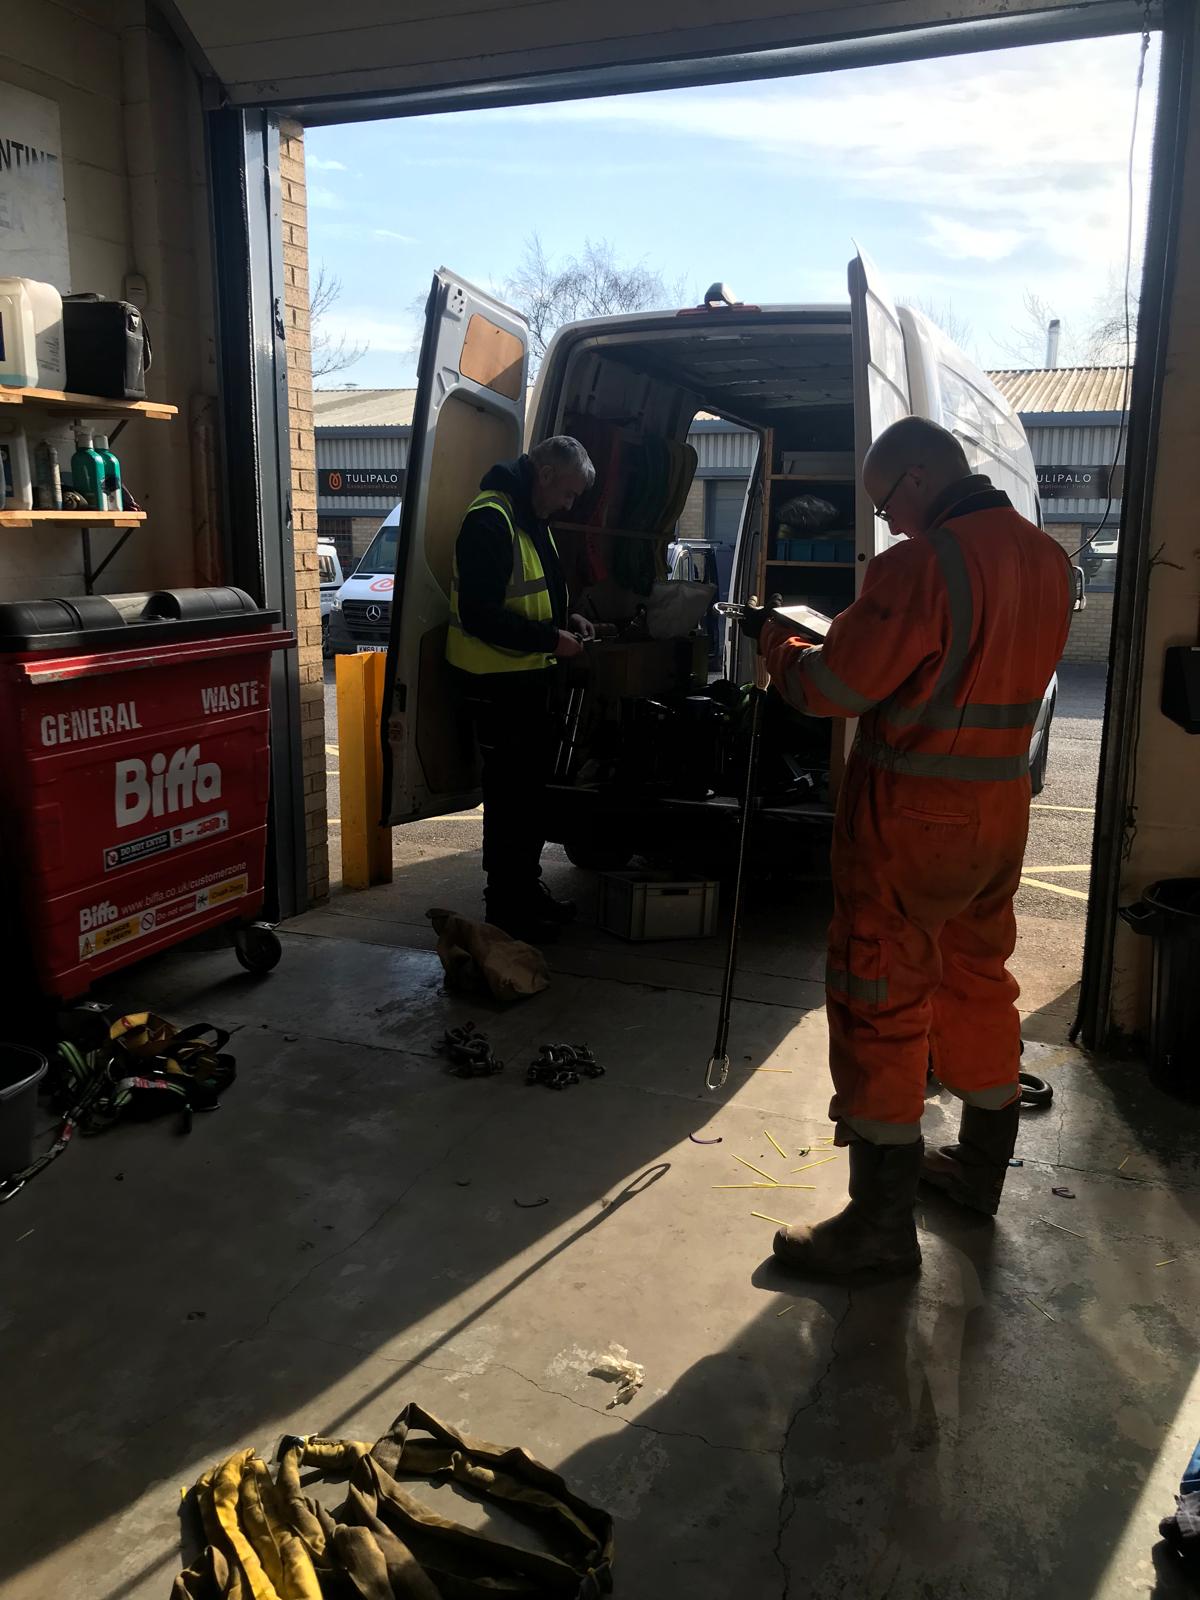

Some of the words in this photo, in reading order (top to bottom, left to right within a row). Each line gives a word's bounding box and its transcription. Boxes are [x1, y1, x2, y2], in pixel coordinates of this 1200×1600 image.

[346, 474, 398, 483] TULIPALO
[1036, 473, 1092, 483] ULIPALO
[40, 700, 142, 747] GENERAL
[201, 681, 260, 715] WASTE
[115, 743, 222, 829] Biffa
[79, 899, 119, 931] Biffa
[121, 861, 247, 915] www.biffa.co.uk/customerzone
